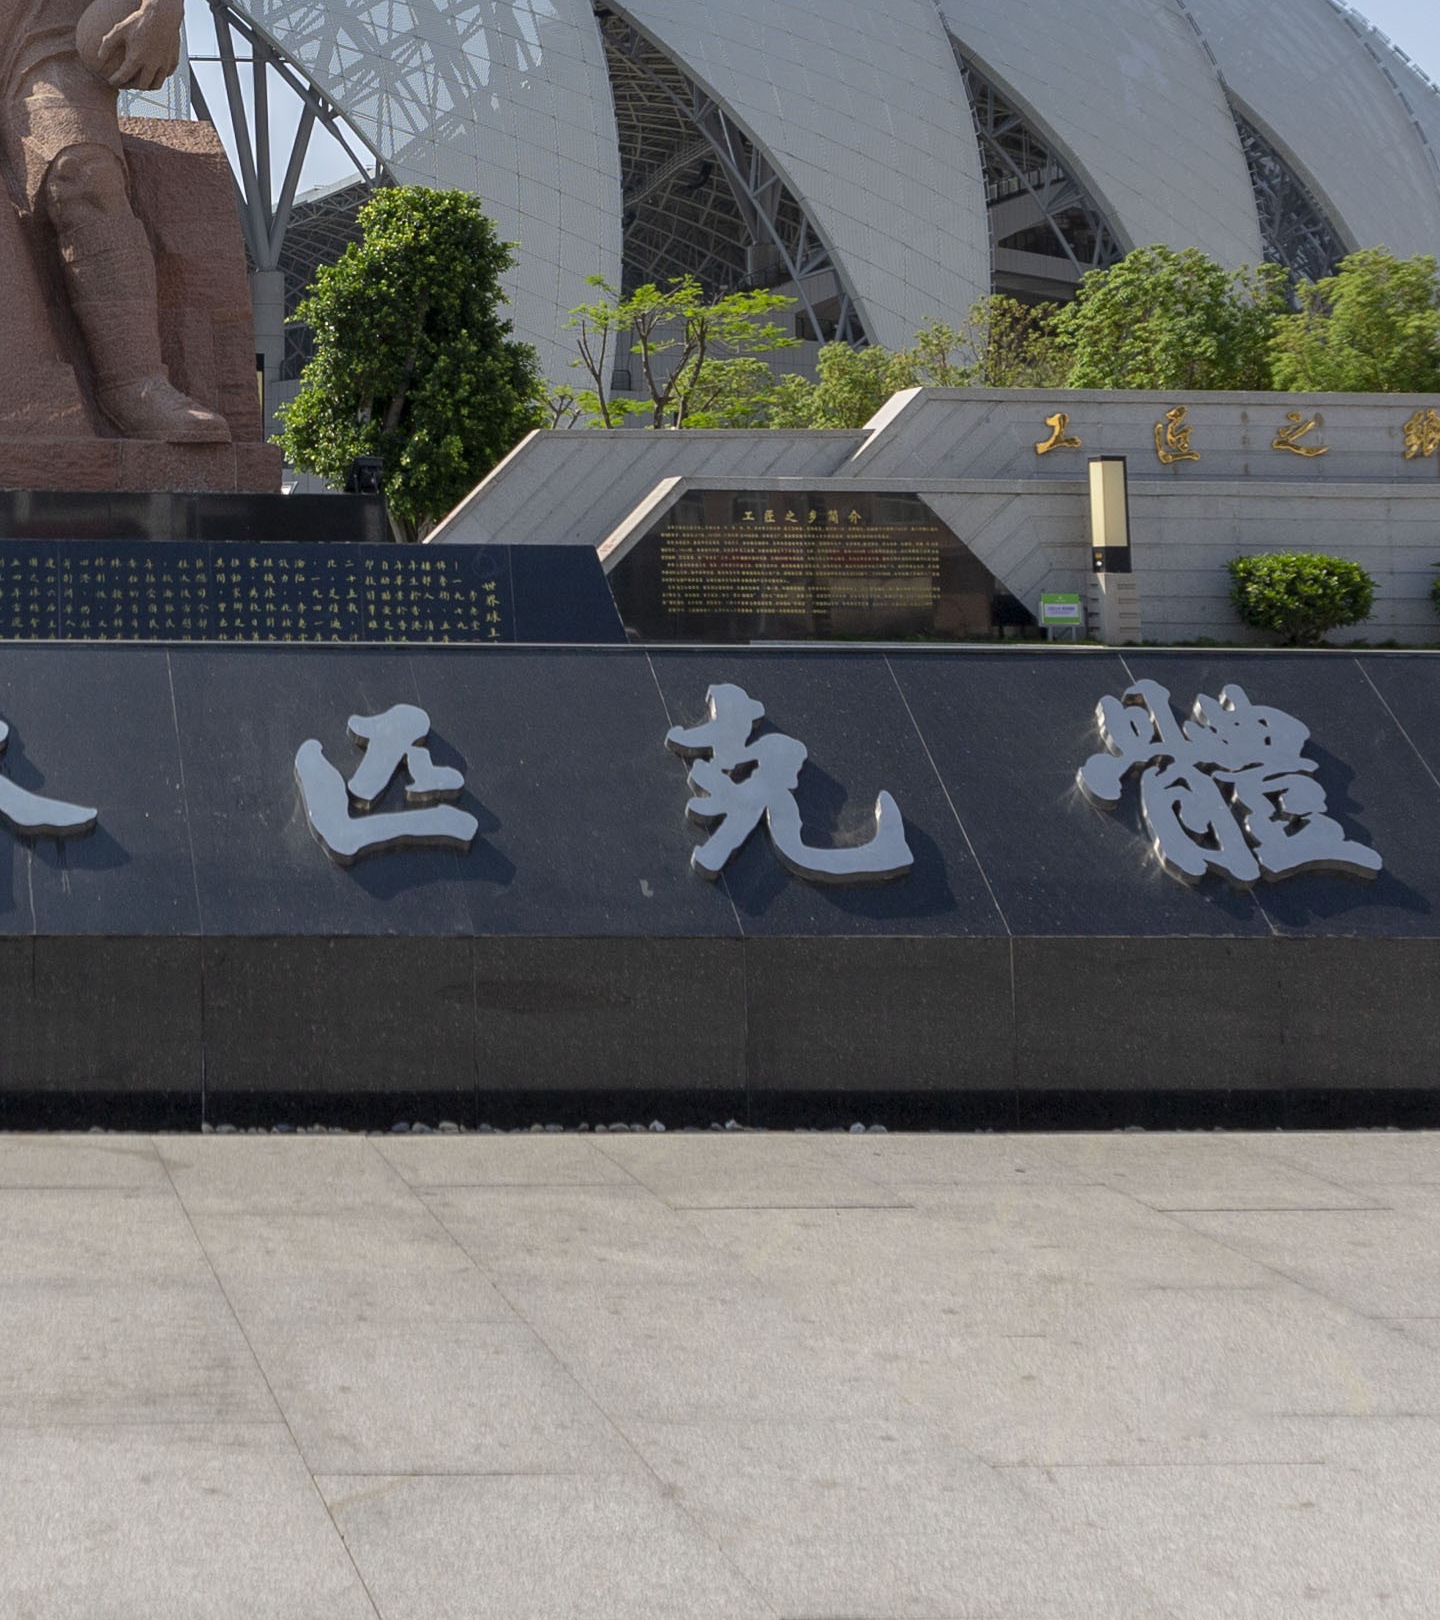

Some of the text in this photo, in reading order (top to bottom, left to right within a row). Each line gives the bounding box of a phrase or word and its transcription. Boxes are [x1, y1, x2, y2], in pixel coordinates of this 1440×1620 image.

[741, 509, 863, 524] 工匠之乡简介
